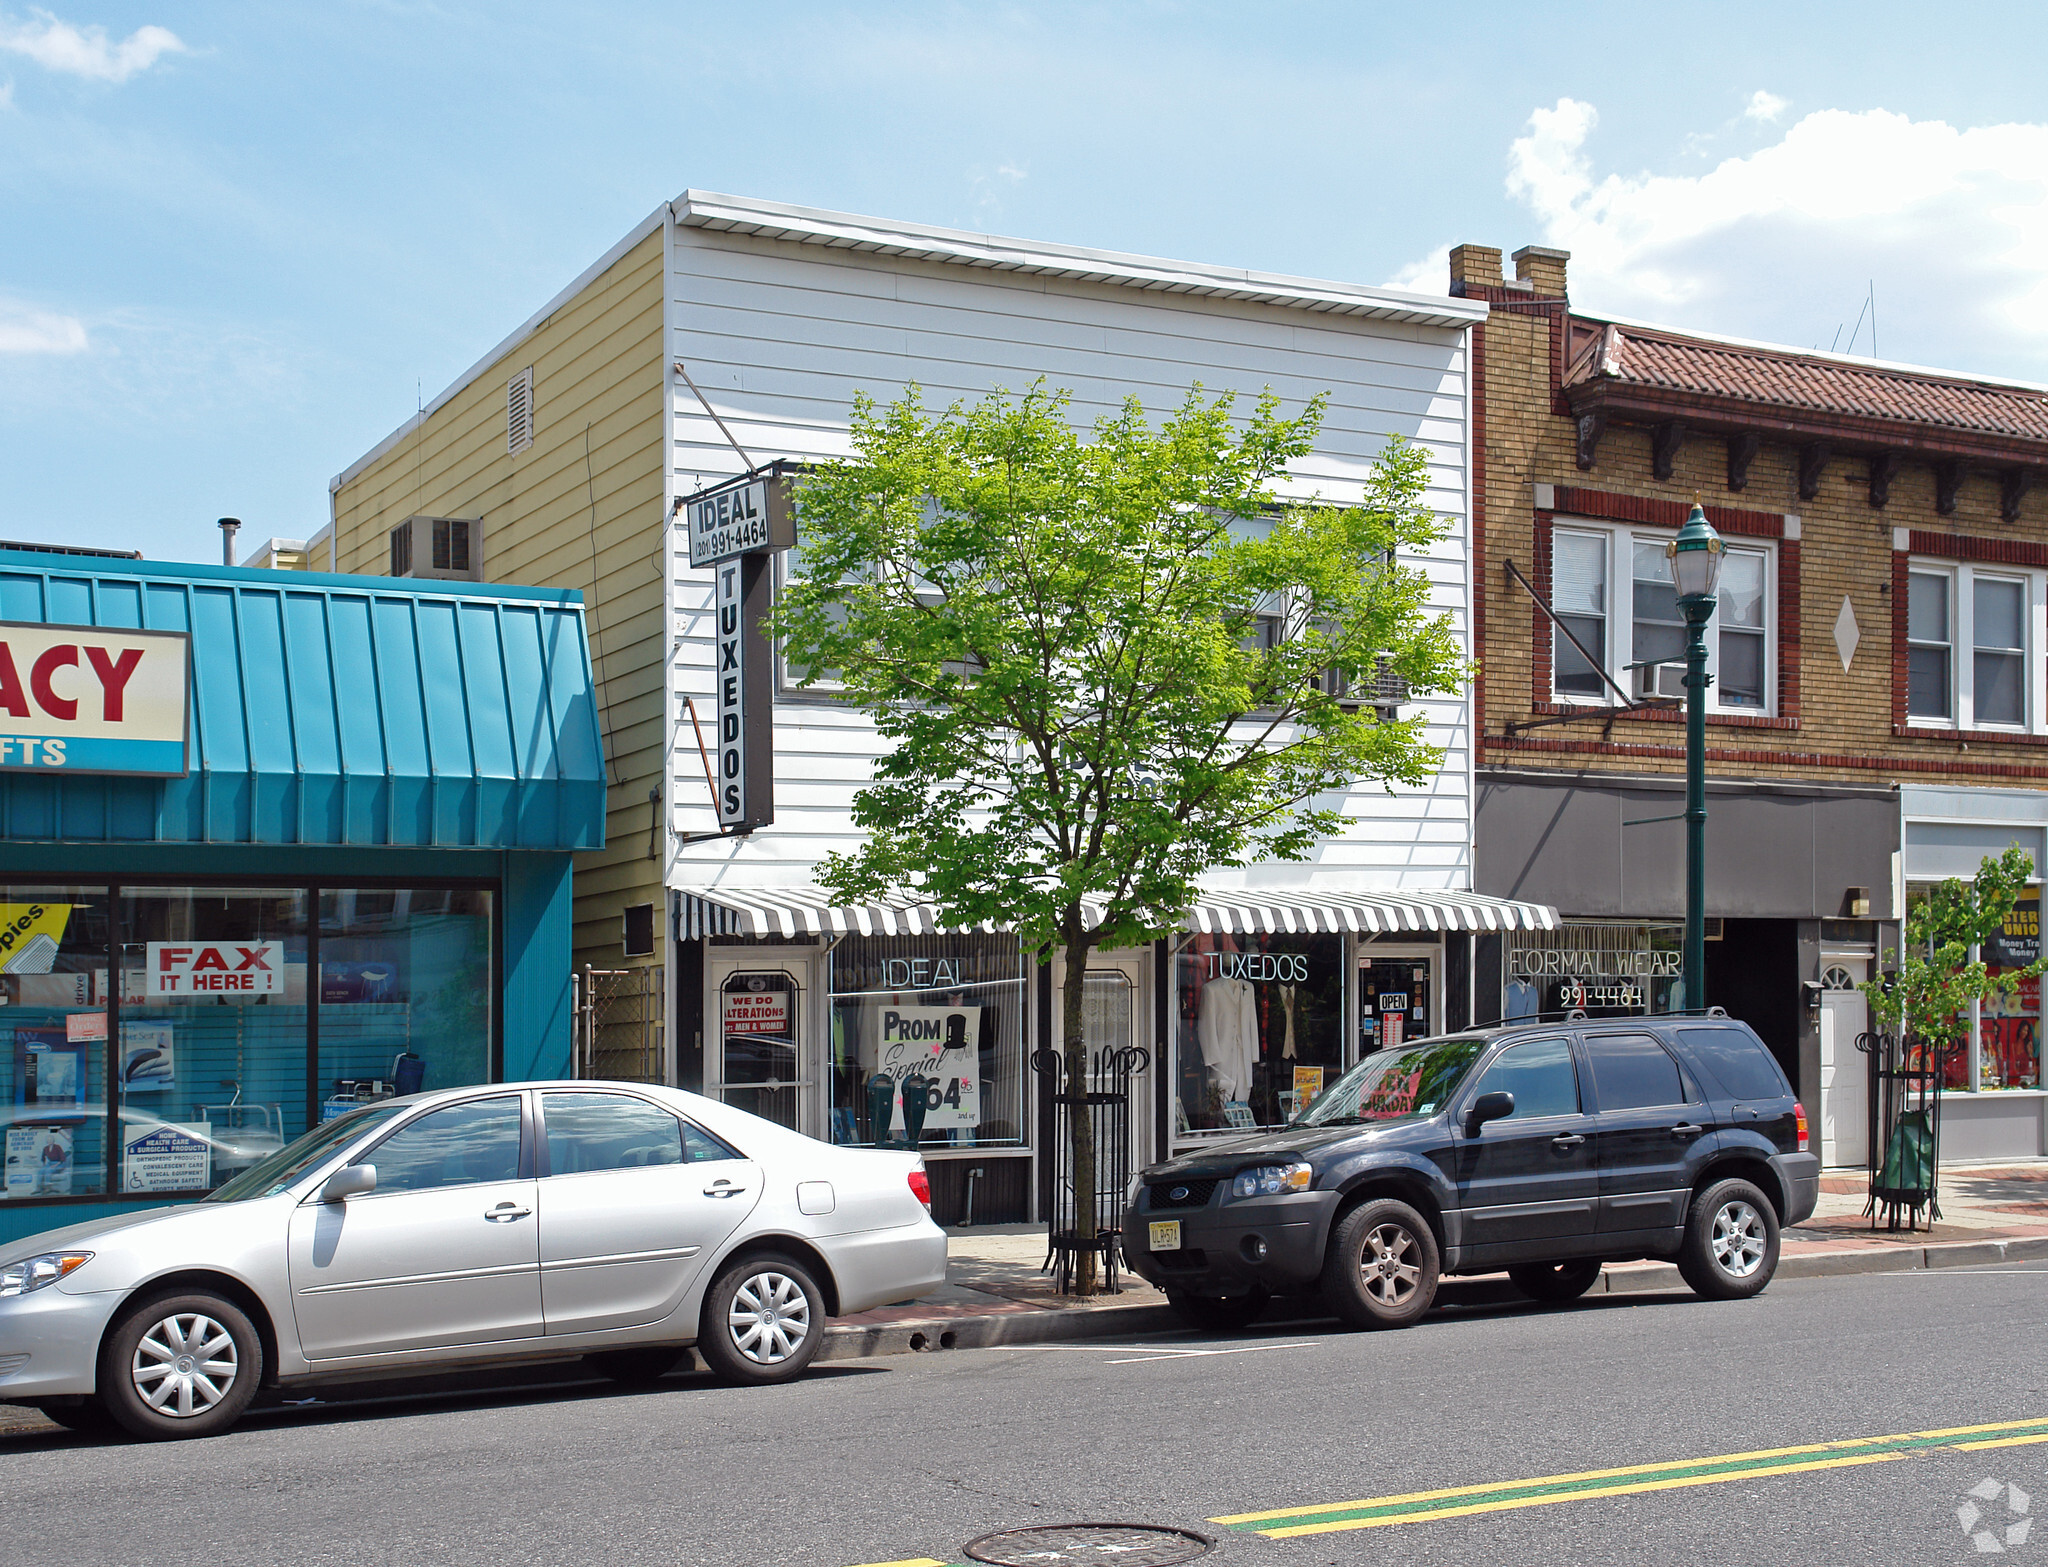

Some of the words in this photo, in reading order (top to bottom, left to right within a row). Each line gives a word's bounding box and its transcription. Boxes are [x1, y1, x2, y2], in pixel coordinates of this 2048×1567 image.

[697, 487, 757, 535] IDEAL
[711, 518, 767, 556] 991-4464
[721, 567, 741, 815] TUXEDOS
[1999, 938, 2025, 949] Money
[2009, 947, 2036, 958] Money
[159, 947, 273, 972] FAX
[1203, 952, 1308, 982] TUXEDOS
[1509, 949, 1610, 976] FORMAL
[1615, 951, 1681, 977] WEAR
[160, 975, 181, 991] IT
[193, 974, 255, 990] HERE
[881, 958, 973, 988] IDEAL
[74, 975, 85, 1005] drive
[99, 995, 145, 1005] PAR
[1560, 986, 1642, 1006] 991-4464
[732, 997, 752, 1005] WE
[755, 996, 773, 1005] DO
[1381, 995, 1405, 1010] OPEN
[735, 1022, 750, 1031] MEN
[752, 1022, 757, 1030] &
[760, 1021, 784, 1030] WOMEN
[137, 1145, 169, 1153] SURGICAL
[171, 1144, 206, 1152] PRODUCTS
